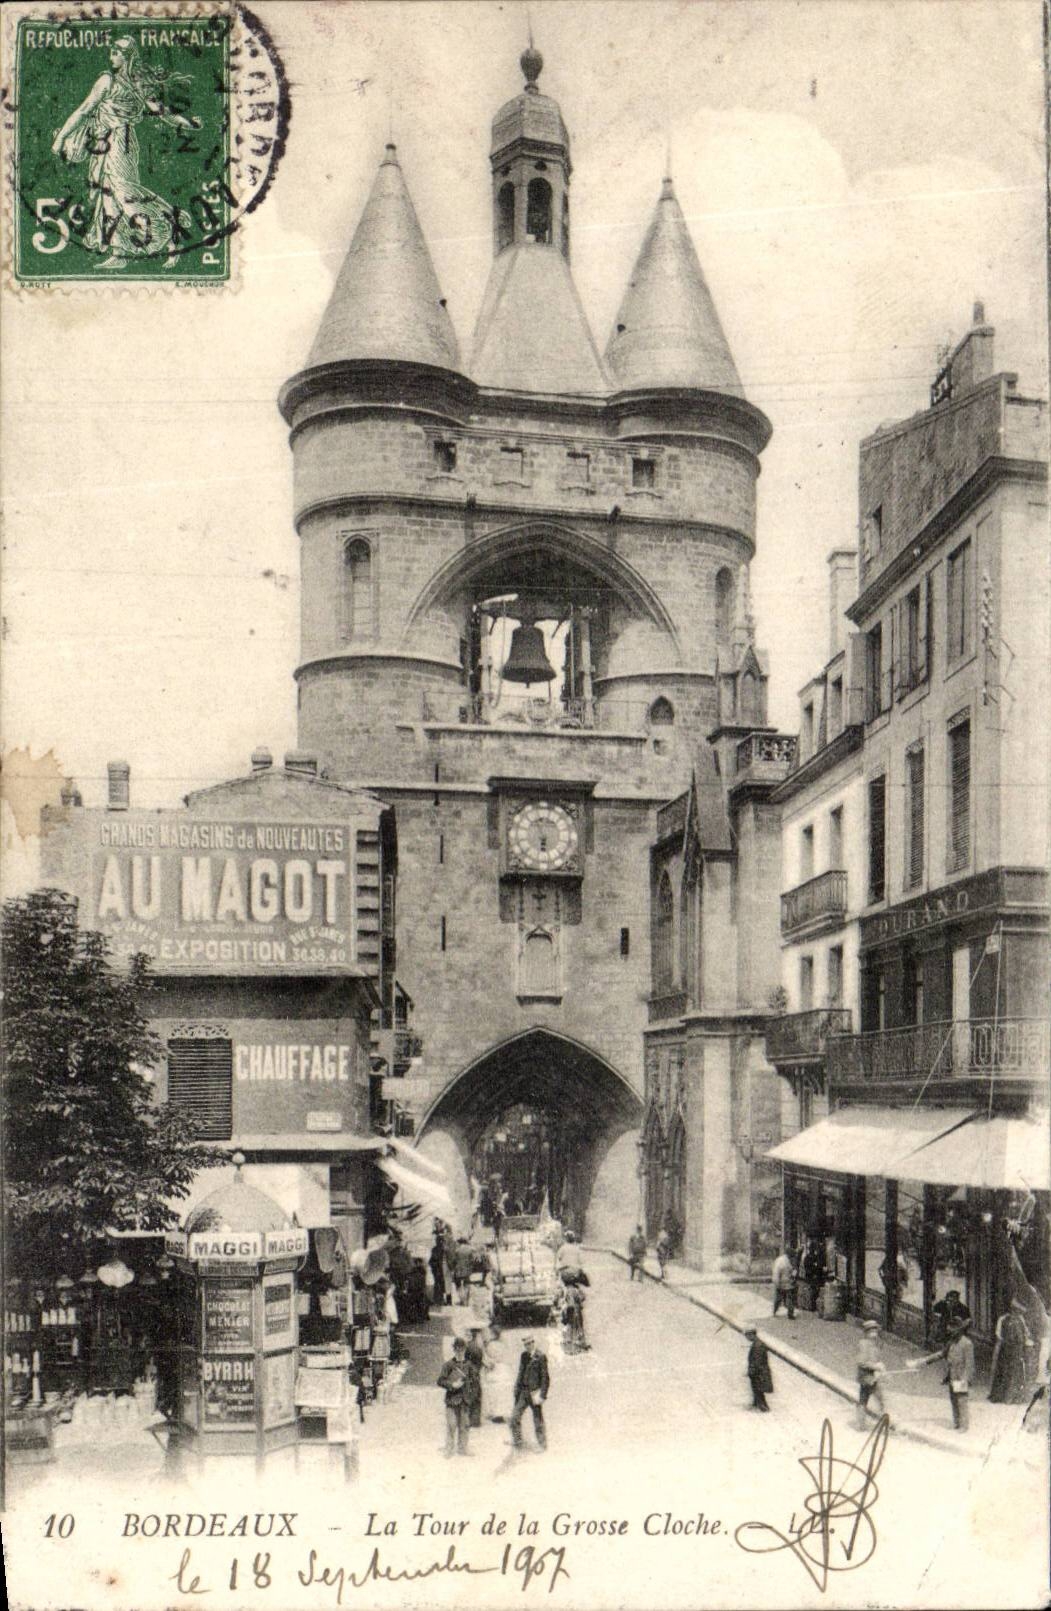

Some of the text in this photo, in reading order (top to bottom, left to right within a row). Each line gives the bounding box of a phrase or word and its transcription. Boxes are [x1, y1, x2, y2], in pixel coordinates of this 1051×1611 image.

[101, 823, 154, 847] GRANDS
[160, 825, 233, 849] MAGASINS
[256, 827, 344, 851] NOUVEAUTES
[98, 855, 346, 924] AU MAGOT
[160, 939, 286, 961] EXPOSITION
[235, 1045, 351, 1081] CHAUFFAGE
[194, 1241, 258, 1256] MAGGI
[204, 1361, 254, 1381] BYRRH
[169, 1547, 212, 1594] le
[229, 1552, 272, 1590] 18
[501, 1543, 570, 1594] 1907
